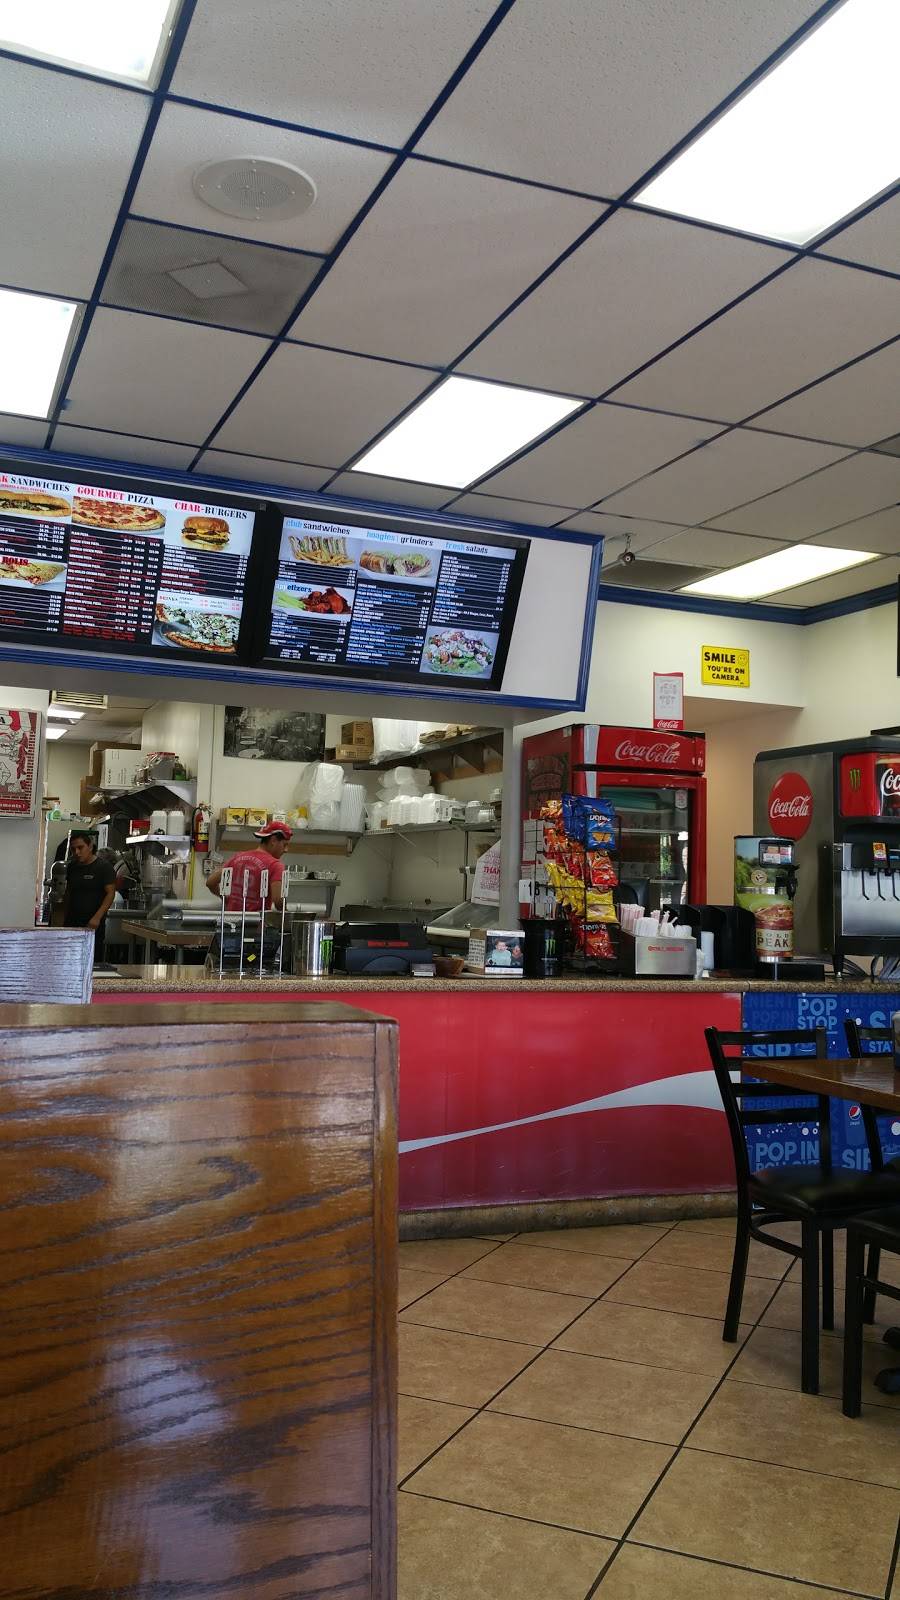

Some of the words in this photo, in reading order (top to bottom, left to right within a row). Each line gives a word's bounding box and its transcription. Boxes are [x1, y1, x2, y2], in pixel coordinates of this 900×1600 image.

[11, 476, 70, 492] SANDWICHES
[77, 485, 125, 501] GOURMET
[127, 492, 154, 505] PIZZA
[174, 501, 248, 519] CHAR-BURGERS
[303, 522, 351, 535] sandwiches
[400, 536, 433, 546] grinders
[445, 542, 465, 551] fresh
[465, 545, 488, 554] salads
[704, 652, 736, 664] SMILE
[707, 665, 732, 673] YOU'RE
[711, 673, 740, 682] CAMERA
[656, 720, 679, 729] Coca-Cola
[614, 739, 681, 764] Coca-Cola
[769, 796, 811, 818] Coca-Cola
[756, 938, 790, 949] PEAK
[797, 998, 838, 1017] POP
[797, 1015, 838, 1031] STOP
[755, 1143, 797, 1163] POP
[801, 1140, 820, 1161] IN
